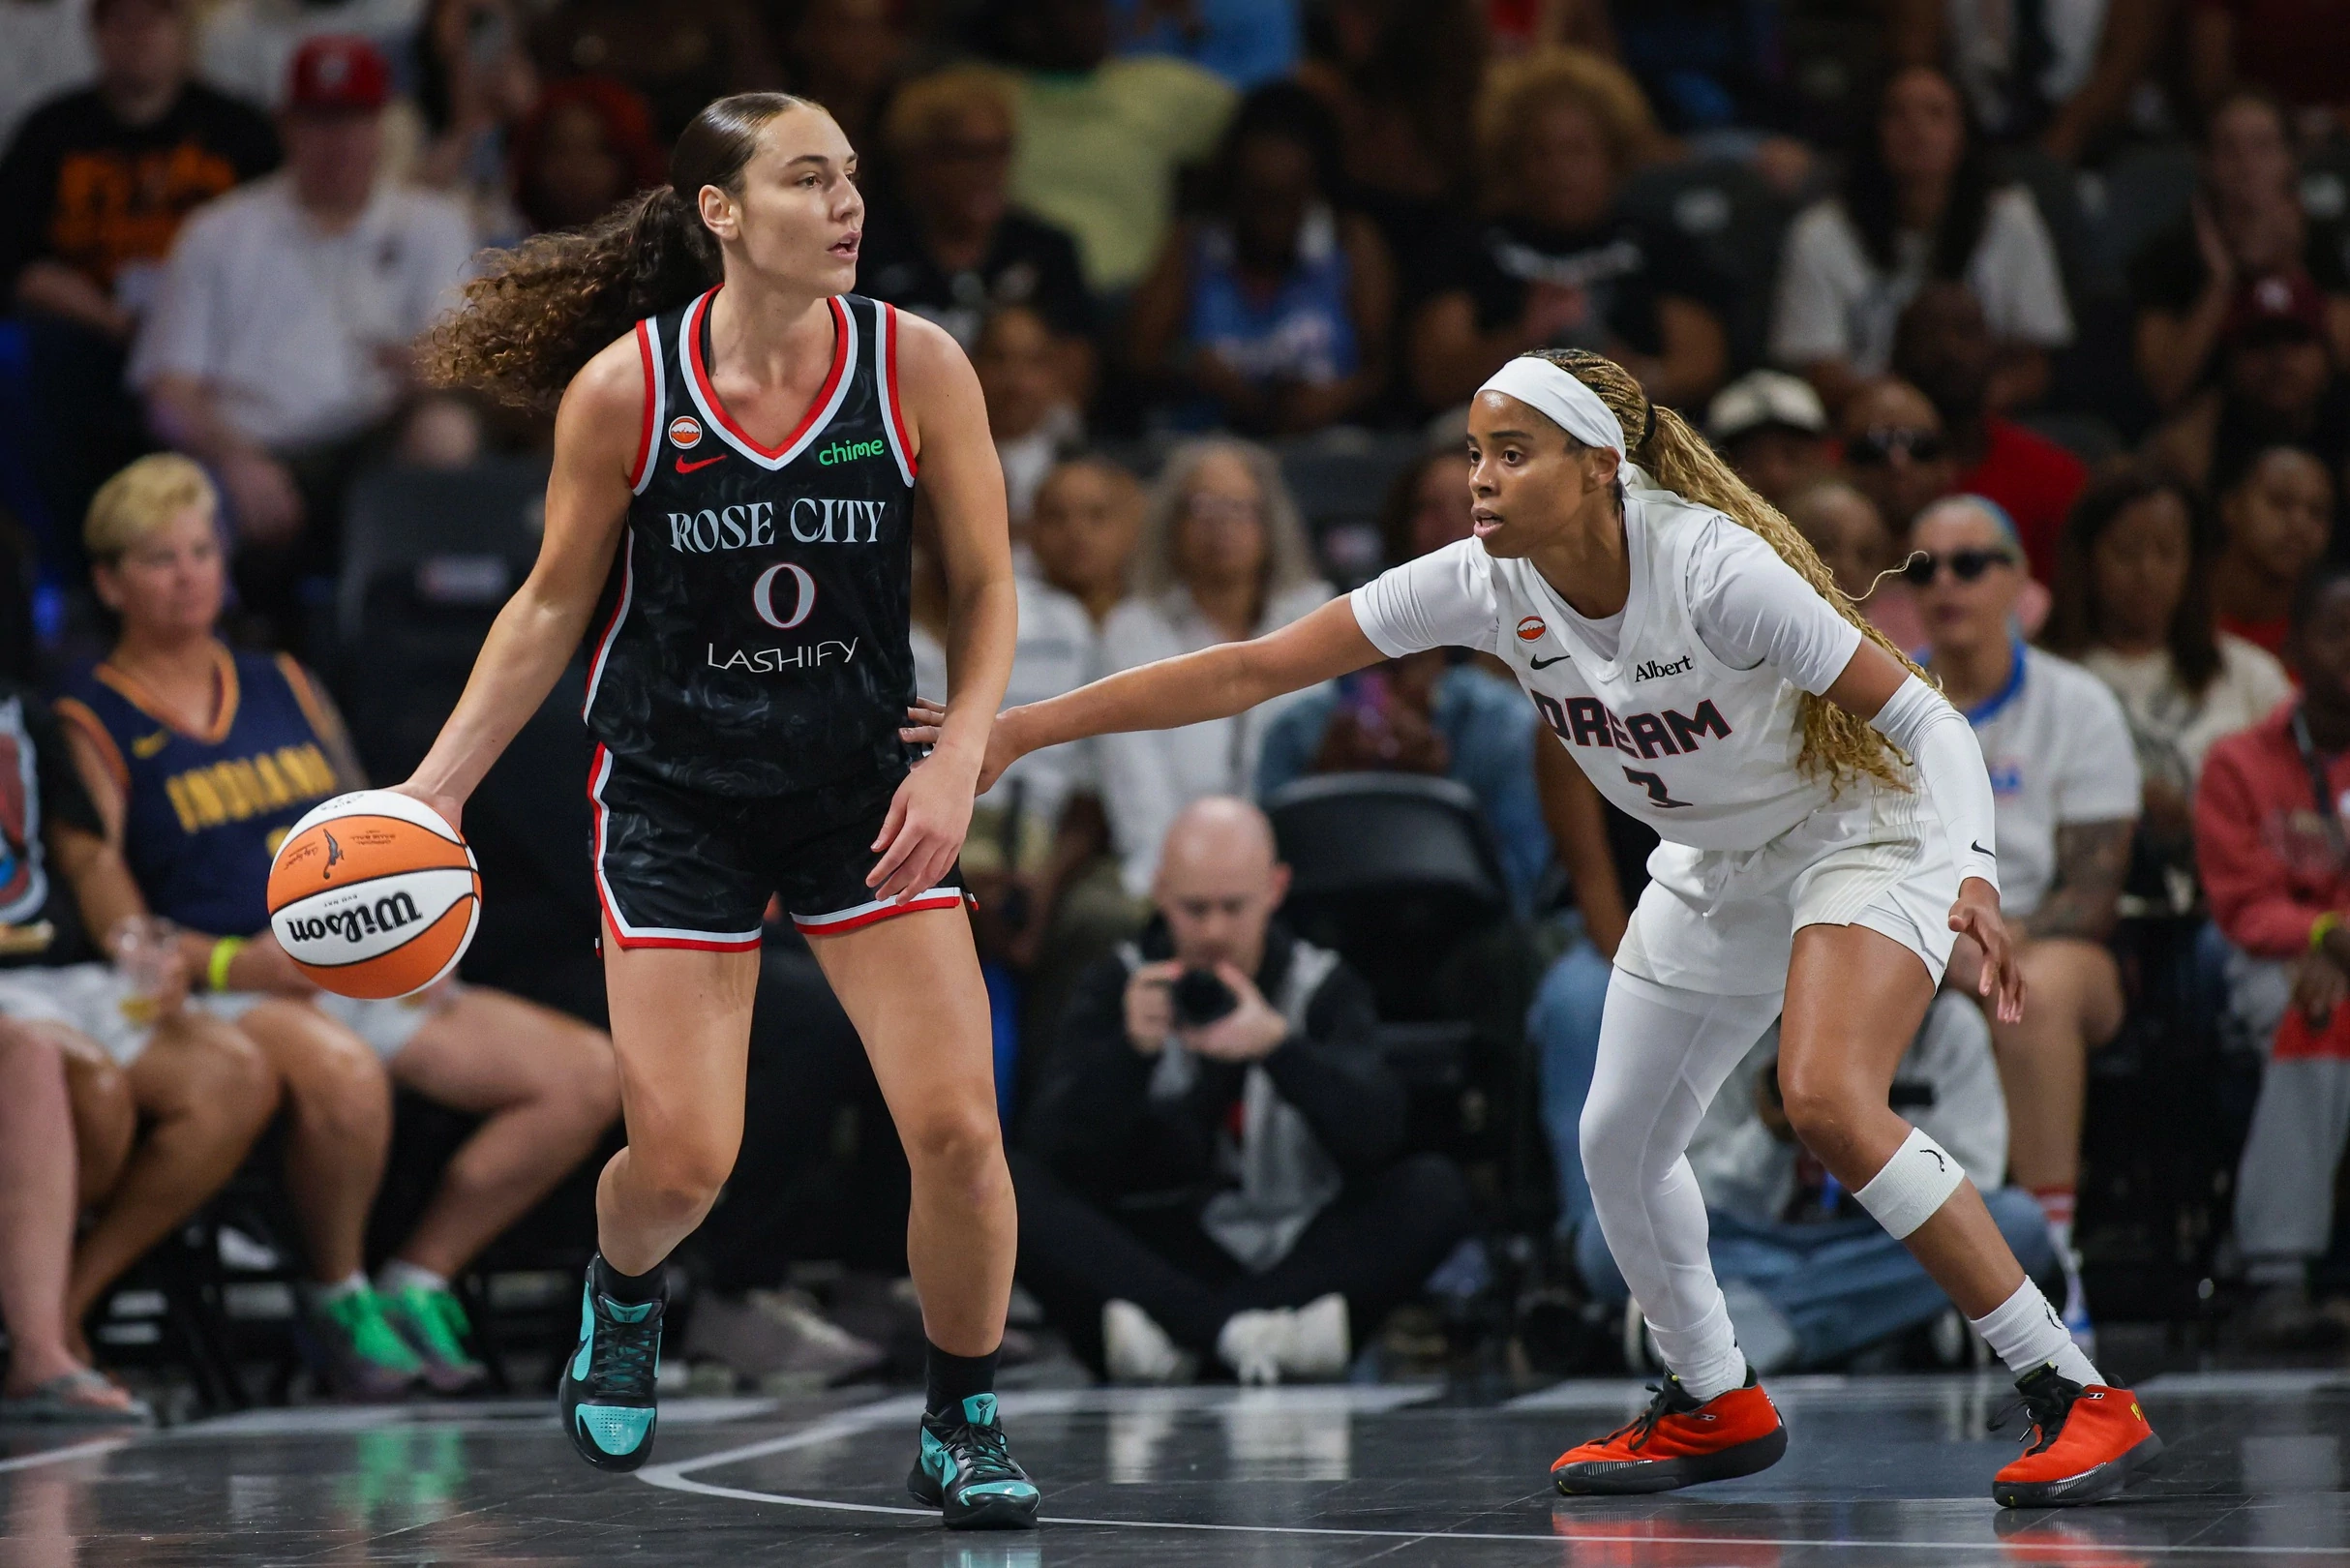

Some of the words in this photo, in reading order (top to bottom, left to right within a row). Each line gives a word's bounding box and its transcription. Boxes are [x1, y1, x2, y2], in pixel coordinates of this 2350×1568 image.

[819, 439, 884, 466] chime
[668, 501, 774, 553] ROSE
[790, 498, 886, 543] CITY
[751, 561, 817, 628] 0
[708, 637, 859, 673] LASHIFY
[1635, 655, 1693, 682] Albert
[1530, 688, 1732, 759] DREAM
[286, 891, 423, 943] Wilson
